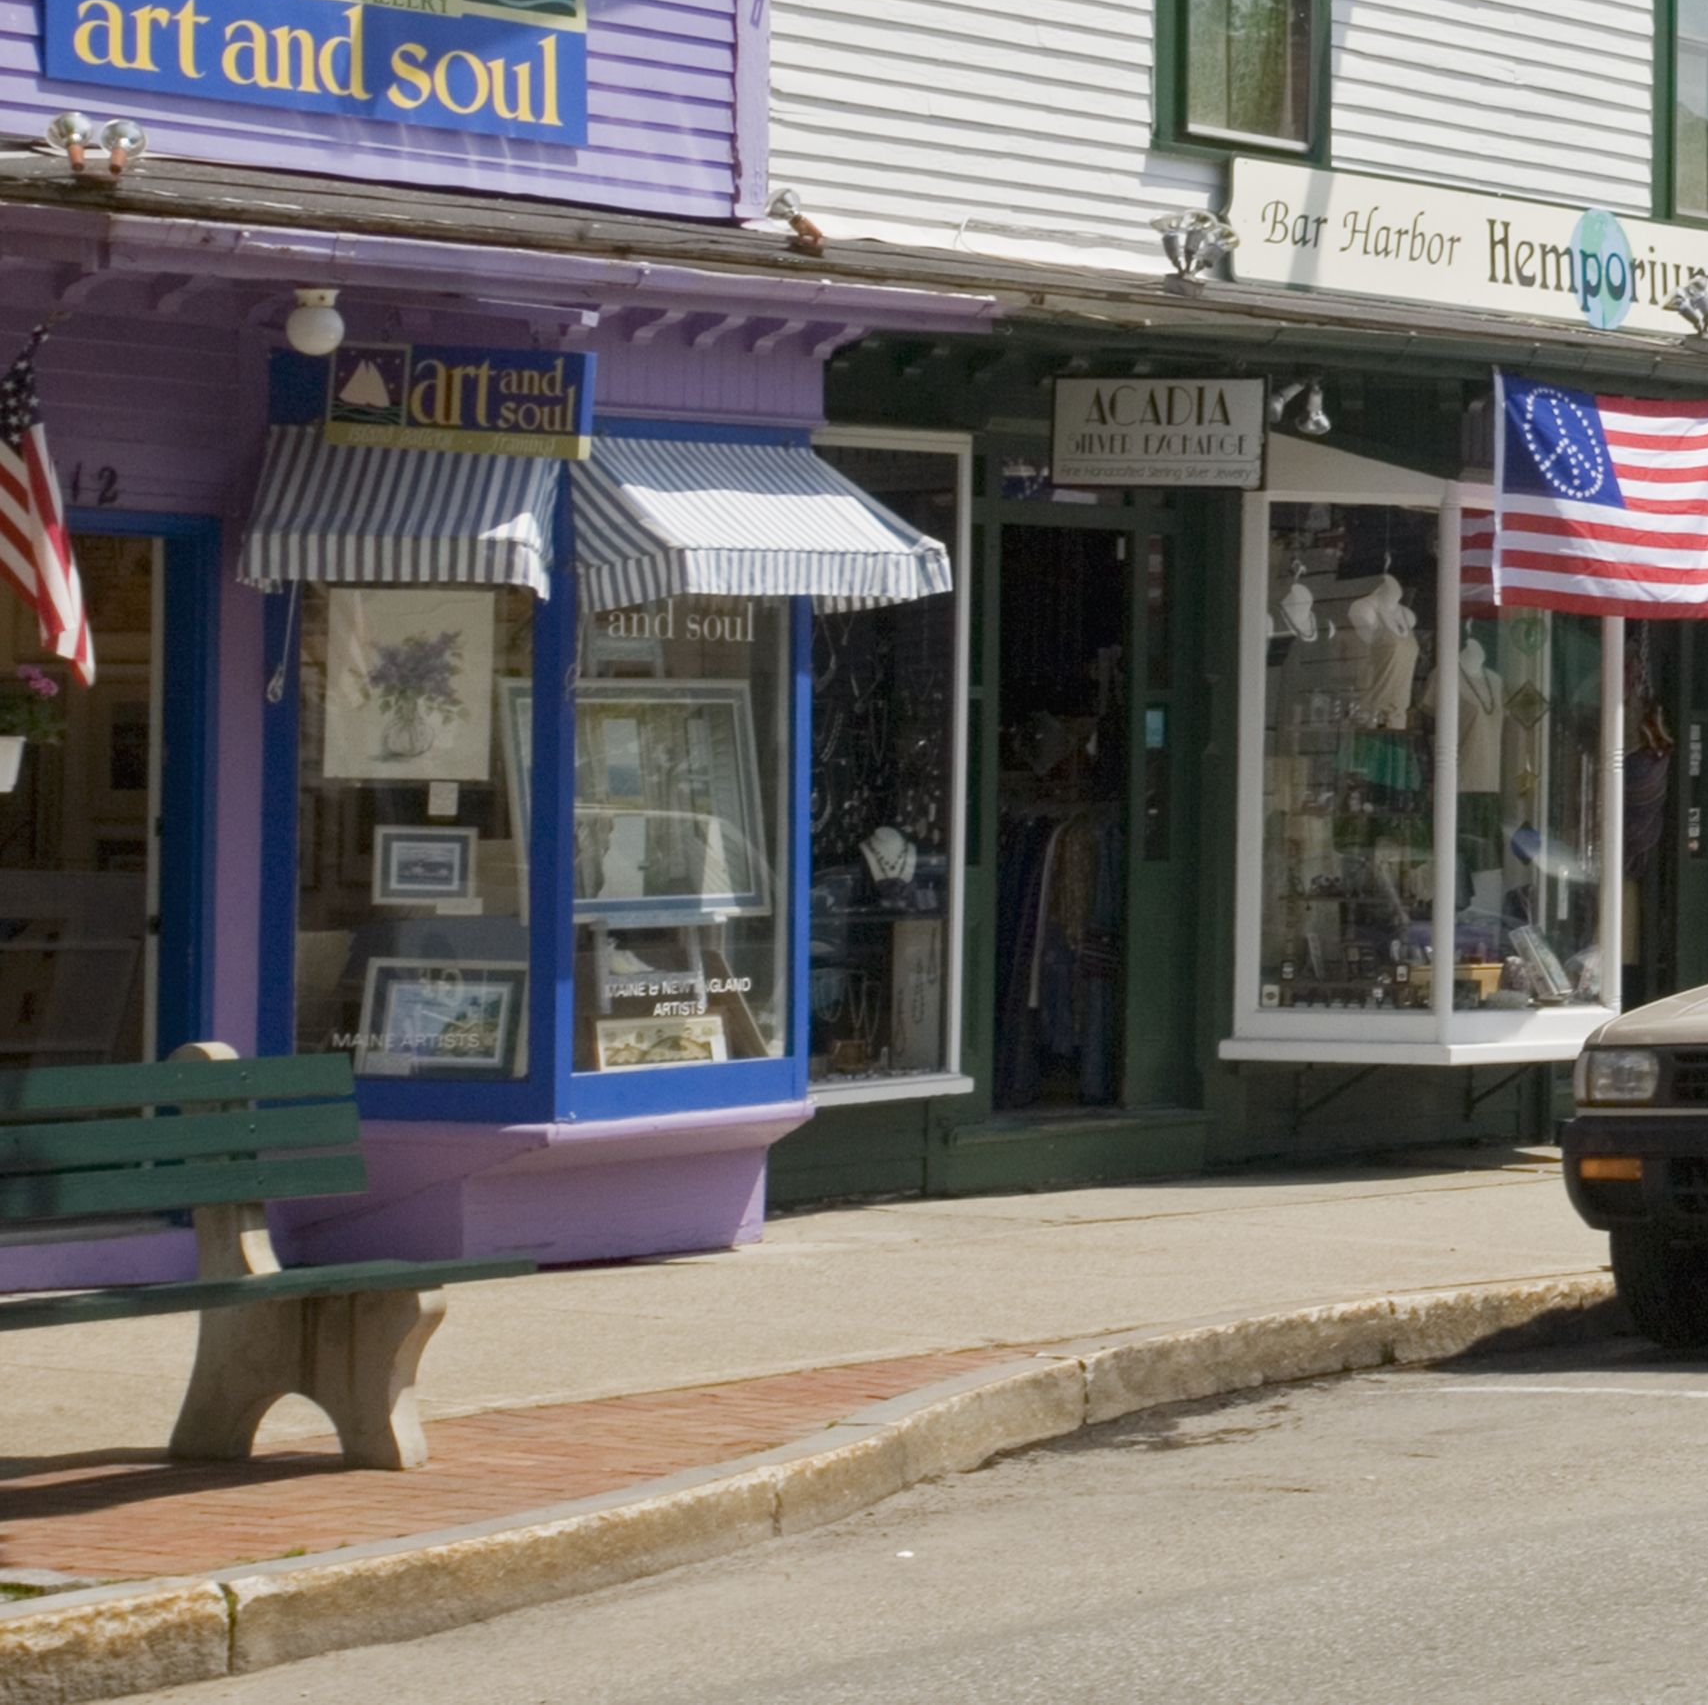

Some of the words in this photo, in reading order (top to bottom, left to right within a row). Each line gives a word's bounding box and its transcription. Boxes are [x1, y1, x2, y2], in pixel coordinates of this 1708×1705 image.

[221, 4, 371, 101] and
[387, 33, 564, 127] soul
[1260, 200, 1328, 249] Bar
[1339, 206, 1462, 267] Harbor
[410, 357, 494, 428] art
[499, 356, 565, 396] and
[496, 385, 576, 432] soul
[1085, 385, 1231, 426] ACADIA
[1067, 433, 1130, 455] SILVER
[1143, 433, 1248, 456] EXCHANGE
[607, 598, 676, 639] and
[685, 601, 755, 642] soul
[653, 1001, 706, 1017] ARTISTS
[332, 1033, 394, 1048] MAINE
[402, 1034, 480, 1048] ARTISTS
